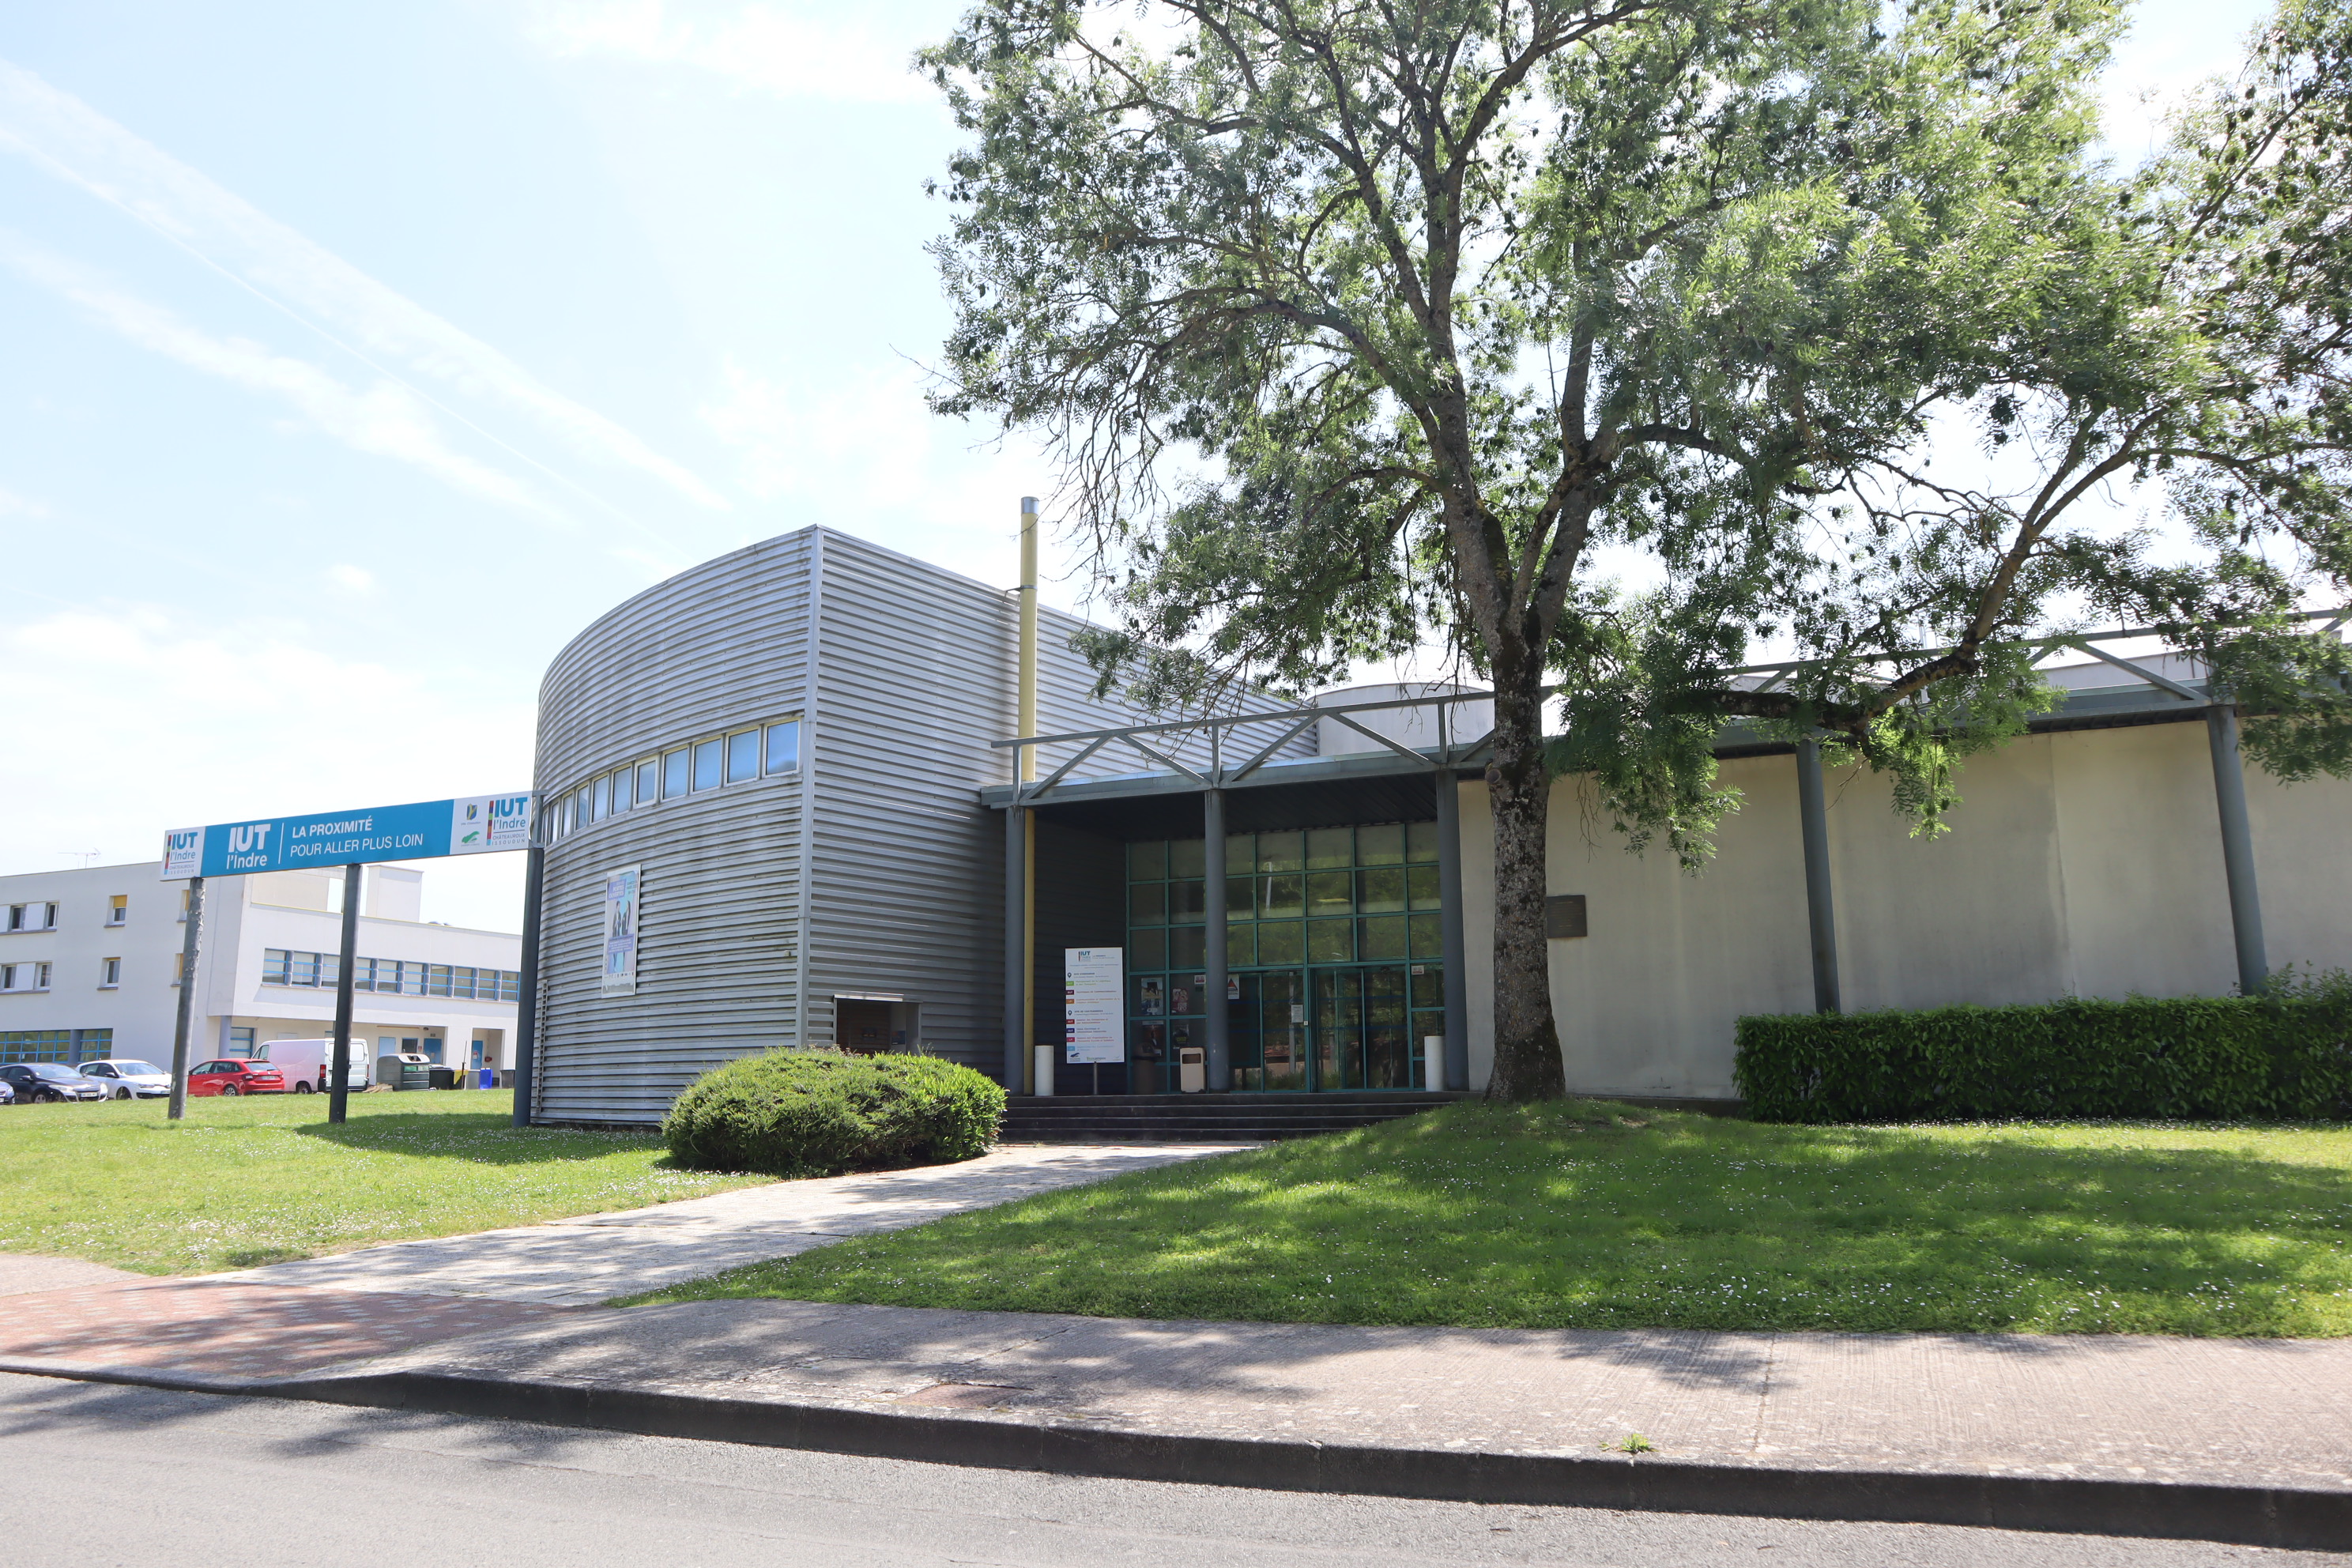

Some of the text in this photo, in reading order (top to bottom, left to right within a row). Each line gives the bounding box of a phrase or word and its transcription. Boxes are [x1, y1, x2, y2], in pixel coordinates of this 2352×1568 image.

[495, 797, 528, 818] IUT
[228, 824, 271, 853] IUT
[292, 816, 373, 839] LA PROXIMITÉ
[172, 831, 198, 850] IUT
[290, 833, 424, 858] POUR ALLER PLUS LOIN
